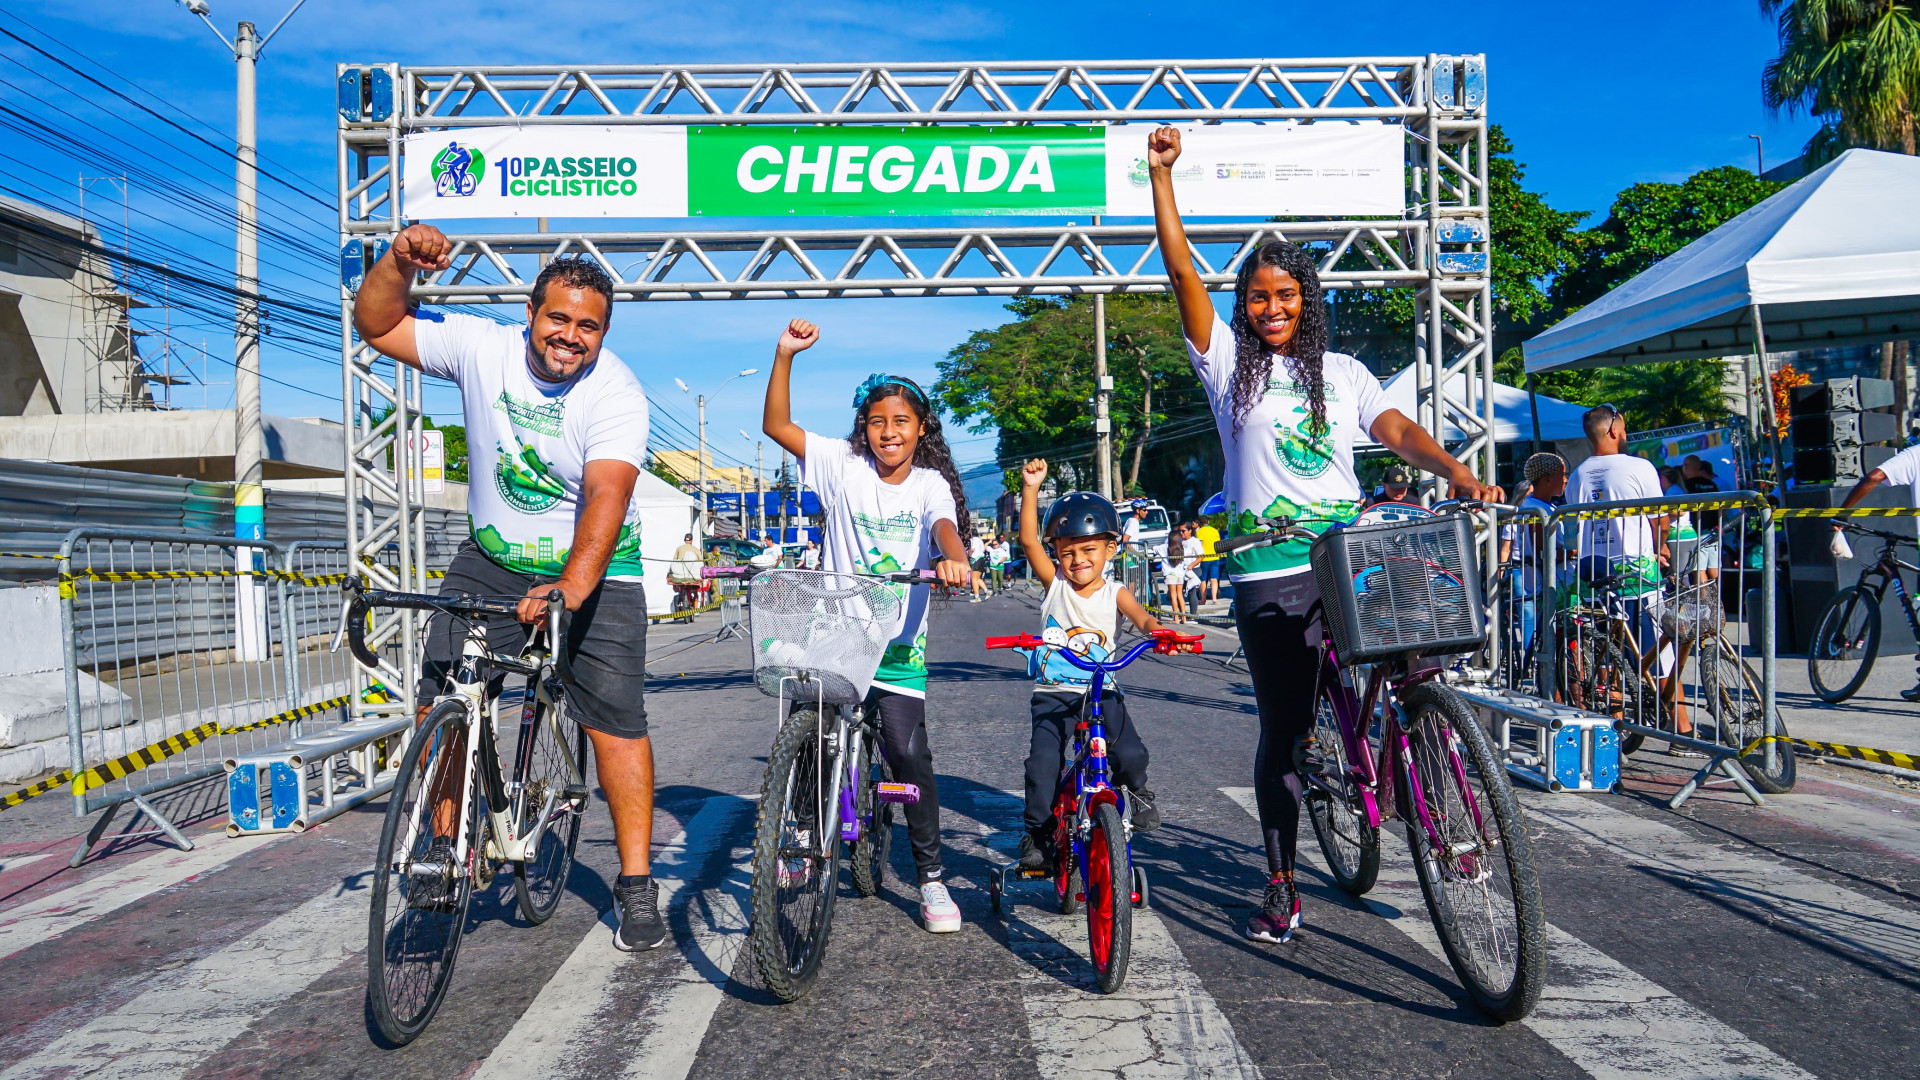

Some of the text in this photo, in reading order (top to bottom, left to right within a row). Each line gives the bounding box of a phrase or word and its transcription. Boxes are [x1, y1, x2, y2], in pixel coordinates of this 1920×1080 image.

[524, 156, 637, 177] PASSEIO
[736, 144, 1056, 194] CHEGADA
[509, 173, 637, 197] CICLÍSTICO
[1277, 449, 1289, 466] MEIO
[1307, 461, 1317, 469] DO
[498, 475, 510, 495] MEIO
[507, 495, 547, 510] AMBIENTE
[529, 494, 543, 503] DO
[505, 819, 513, 833] PRO
